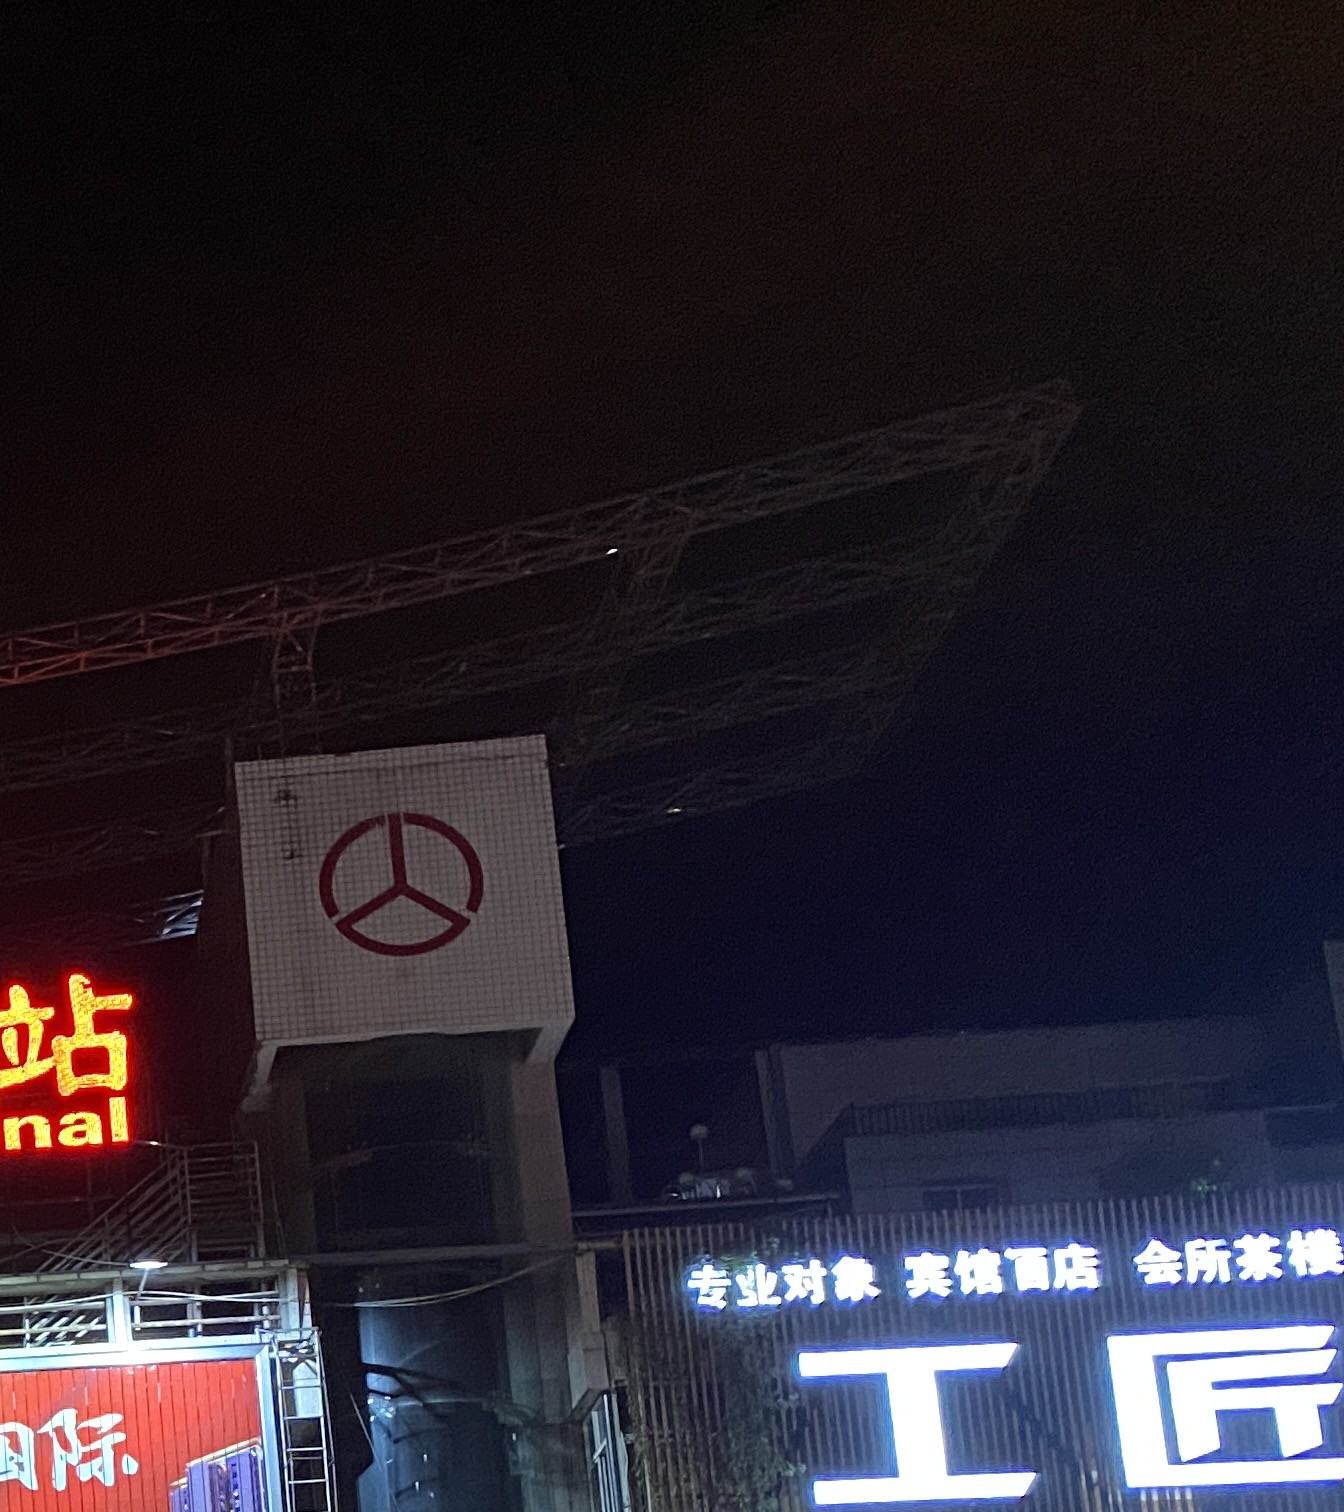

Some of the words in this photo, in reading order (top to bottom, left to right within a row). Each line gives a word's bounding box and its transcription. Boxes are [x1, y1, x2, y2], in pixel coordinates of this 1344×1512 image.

[686, 1254, 880, 1310] 专业对象
[904, 1241, 1102, 1299] 宾馆酒店
[798, 1324, 1344, 1506] 工匠
